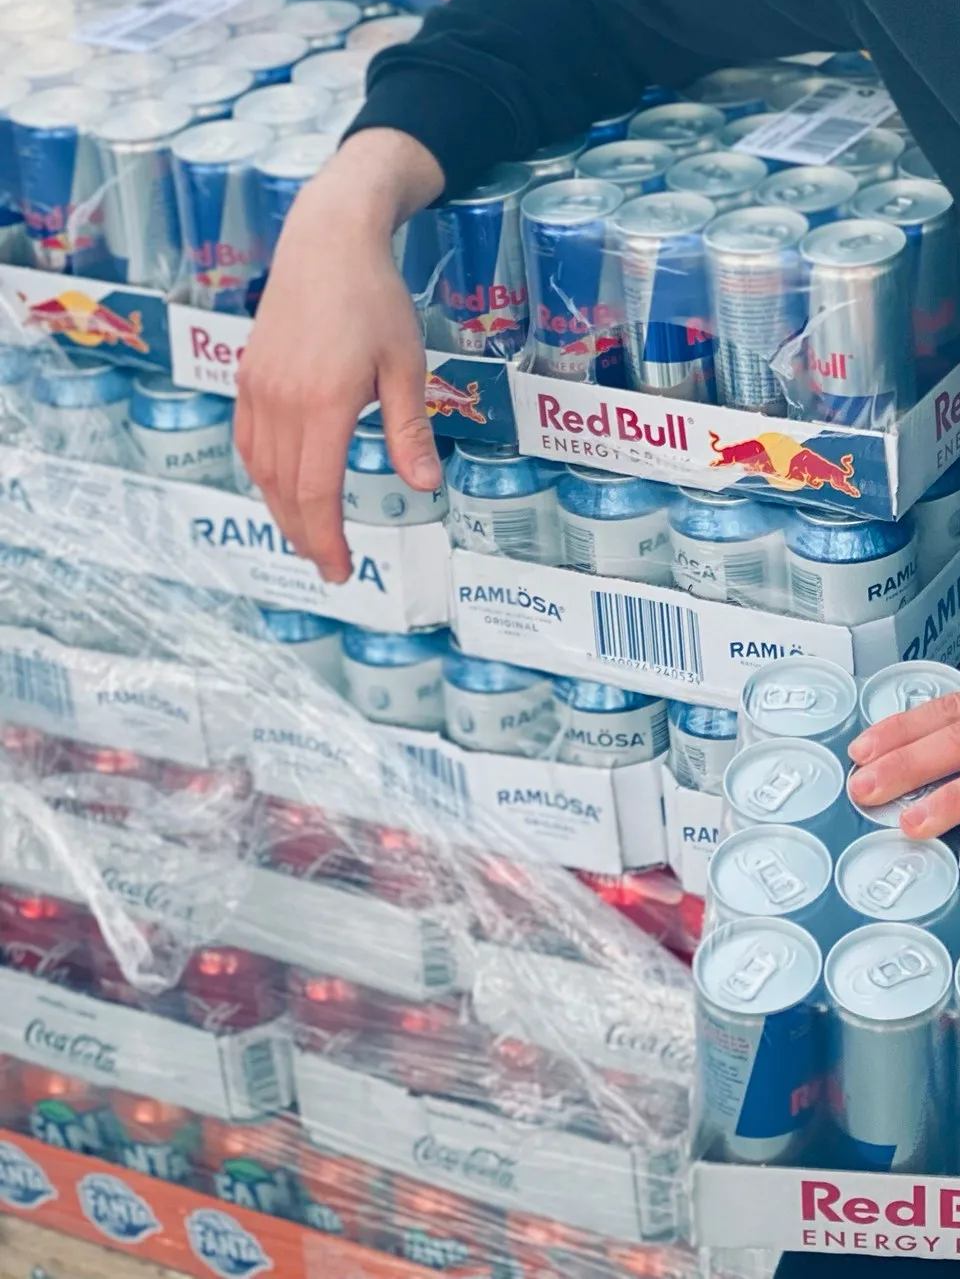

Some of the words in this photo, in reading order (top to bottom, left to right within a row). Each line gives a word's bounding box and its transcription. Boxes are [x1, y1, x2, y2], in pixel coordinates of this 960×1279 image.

[190, 326, 247, 365] Re
[194, 364, 236, 386] ENE
[537, 393, 611, 438] Red
[615, 406, 688, 451] Bull
[541, 434, 621, 460] ENERGY
[191, 517, 387, 594] RAMLA
[867, 554, 919, 602] RAML
[459, 585, 562, 622] RAMLÖSA
[483, 614, 540, 633] ORIGINAL
[801, 1180, 926, 1227] Red
[803, 1229, 940, 1253] ENERGY
